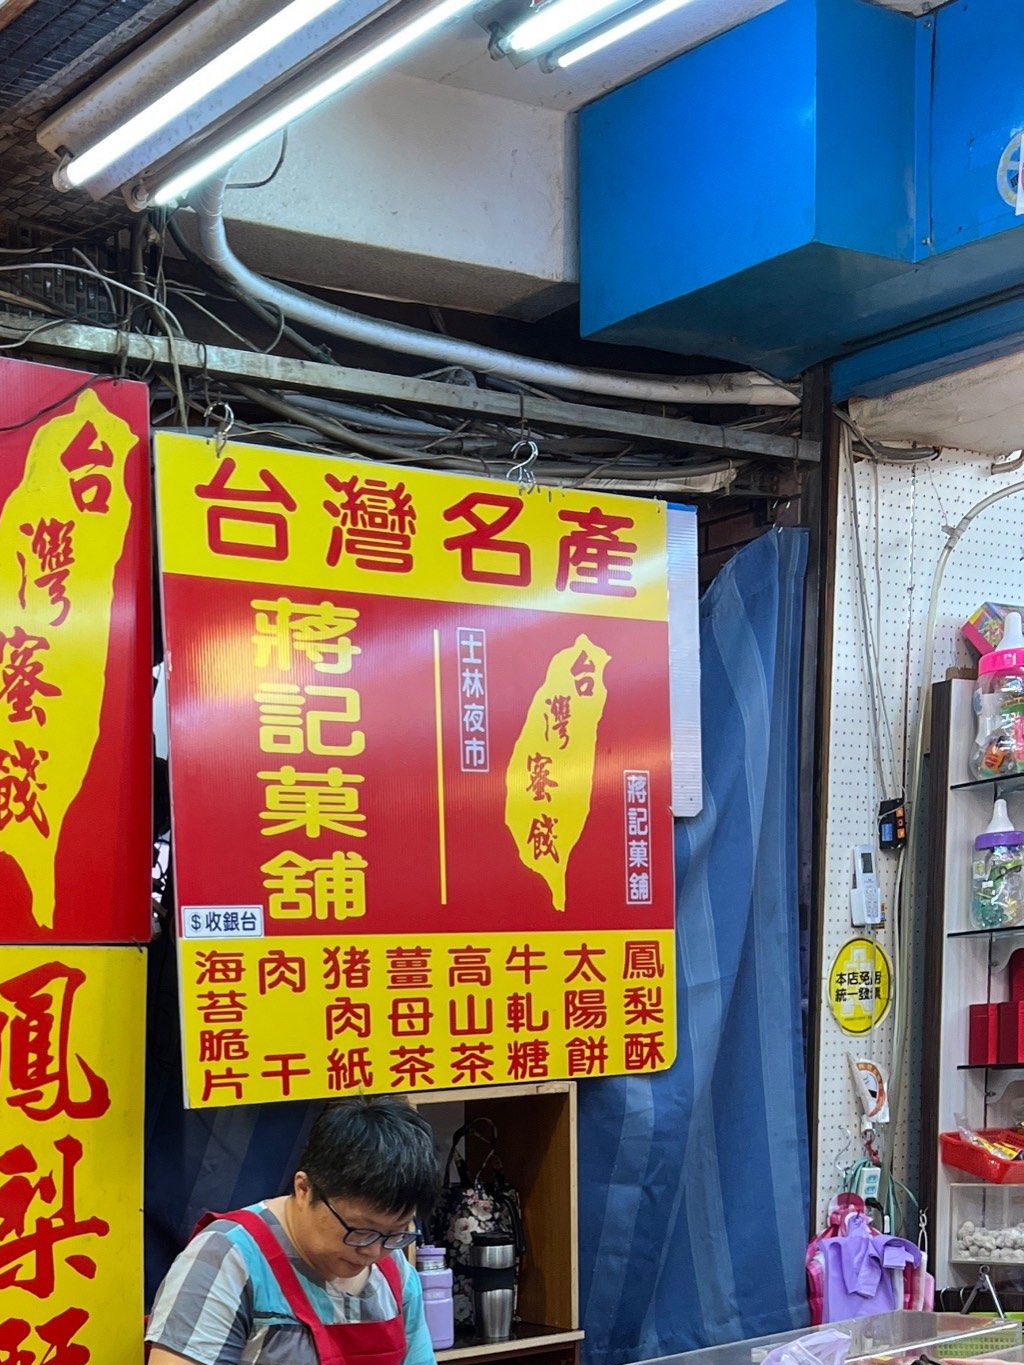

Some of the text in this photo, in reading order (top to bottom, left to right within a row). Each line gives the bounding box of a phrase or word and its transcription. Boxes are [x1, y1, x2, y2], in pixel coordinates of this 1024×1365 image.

[195, 456, 638, 597] 台灣名產
[250, 598, 367, 921] 蔣記菓舖
[461, 635, 487, 767] 士林夜市
[526, 650, 598, 864] 台灣蜜餞
[627, 775, 649, 900] 蔣記菓舖
[195, 948, 250, 1101] 海苔脆片
[258, 950, 311, 1096] 肉干
[385, 947, 435, 1087] 薑母茶
[447, 946, 495, 1084] 高山茶
[506, 943, 550, 1080] 牛軋糖
[563, 942, 608, 1077] 太陽餅
[623, 939, 666, 1071] 鳳梨酥
